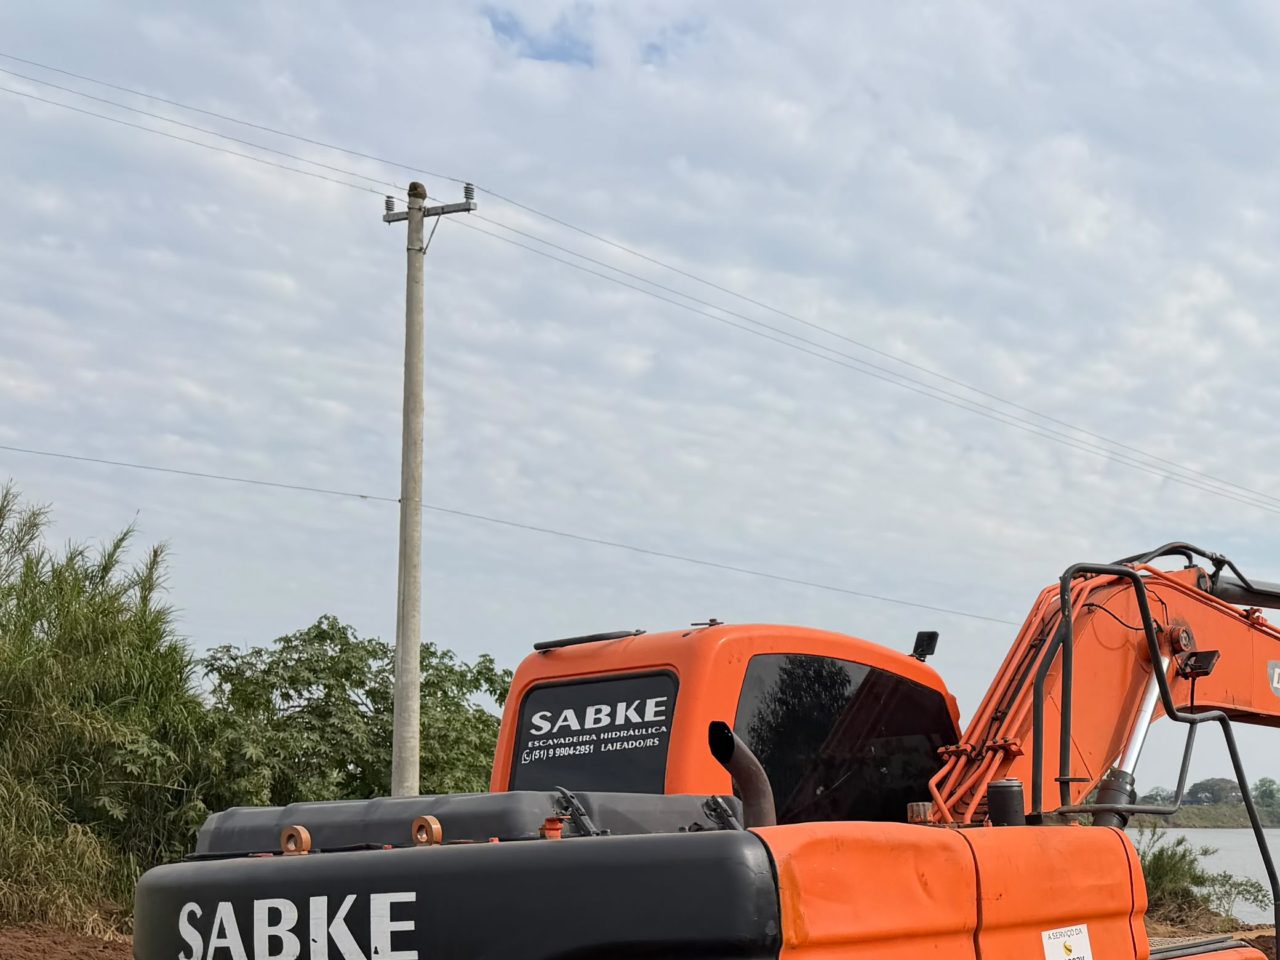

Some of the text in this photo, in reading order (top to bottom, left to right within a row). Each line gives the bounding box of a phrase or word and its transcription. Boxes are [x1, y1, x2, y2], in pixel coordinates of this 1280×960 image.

[529, 697, 668, 735] SABKE
[528, 726, 667, 748] ESCAVADEIRA HIDRÁULICA
[532, 737, 660, 761] (51) 9 9904-2951 LAJEADO/RS
